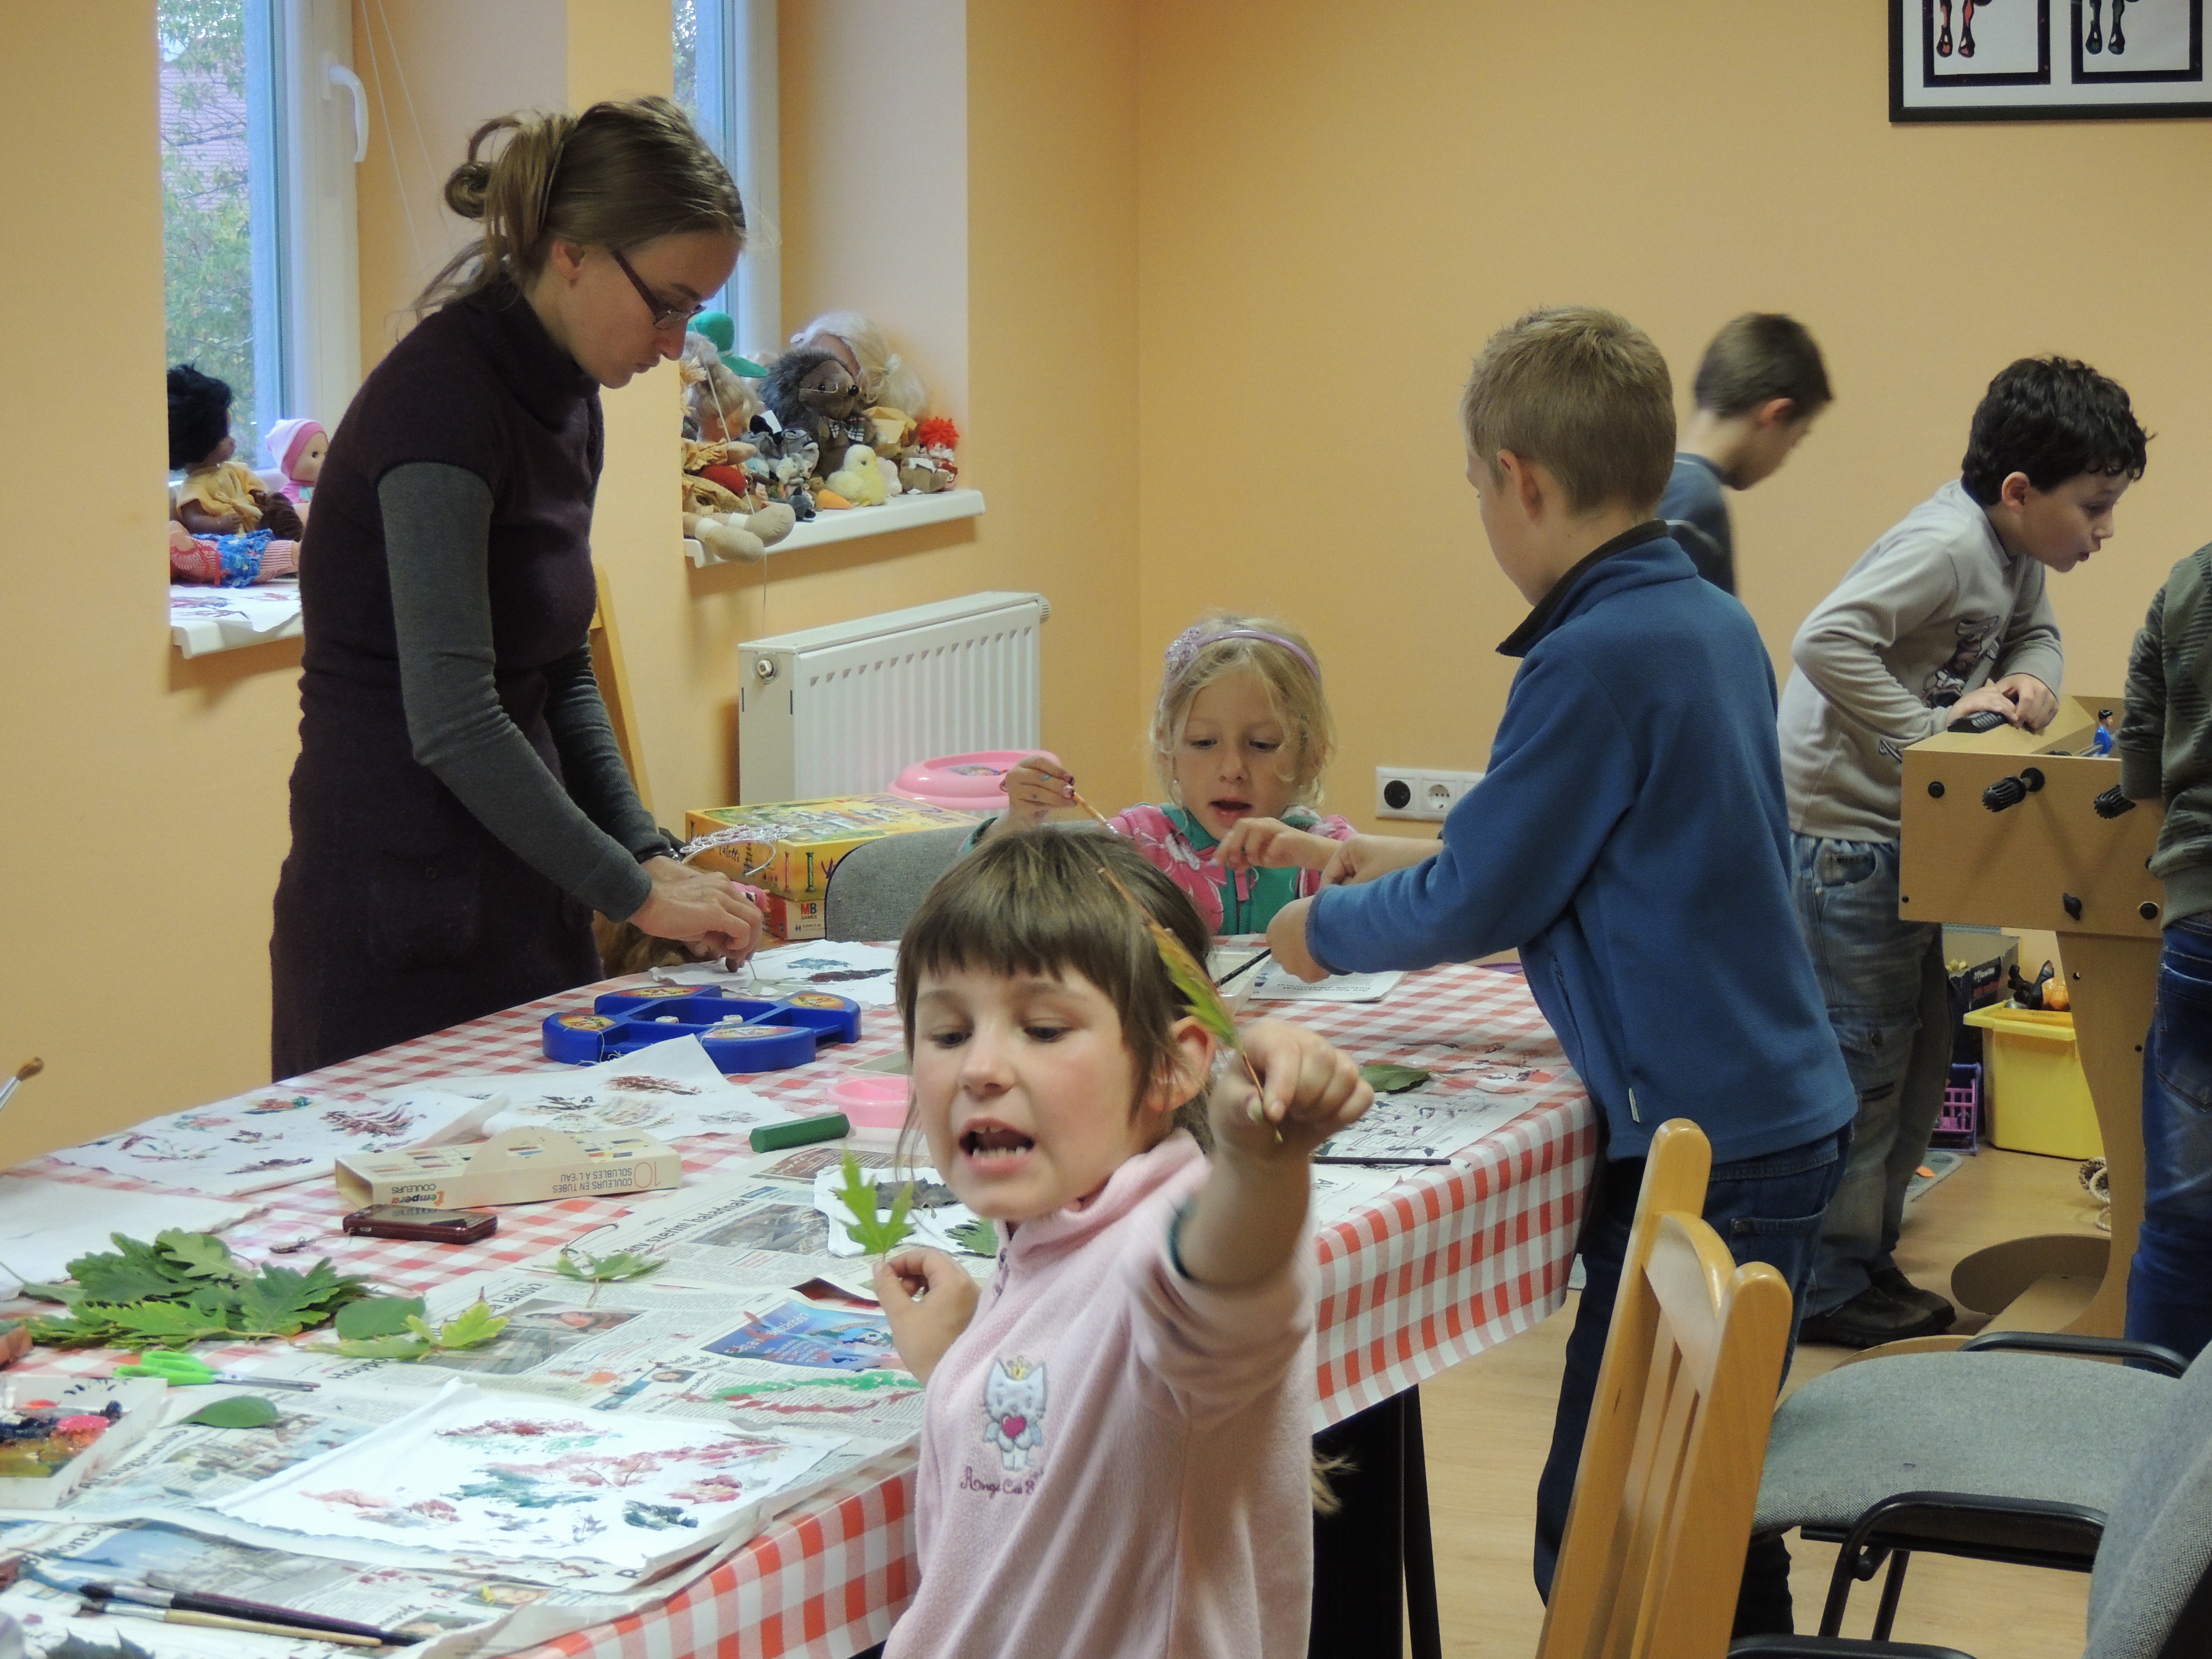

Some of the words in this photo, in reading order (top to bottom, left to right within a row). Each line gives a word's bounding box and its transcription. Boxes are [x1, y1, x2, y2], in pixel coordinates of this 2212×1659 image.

[801, 902, 817, 914] MB
[593, 1167, 632, 1178] SOLUBLES
[634, 1161, 661, 1188] 10
[392, 1183, 436, 1194] COULEURS
[553, 1183, 577, 1193] TUBES
[592, 1178, 632, 1189] COULEURS
[391, 1190, 445, 1207] tempera
[647, 1223, 692, 1243] szerint
[683, 1198, 755, 1224] haladnak
